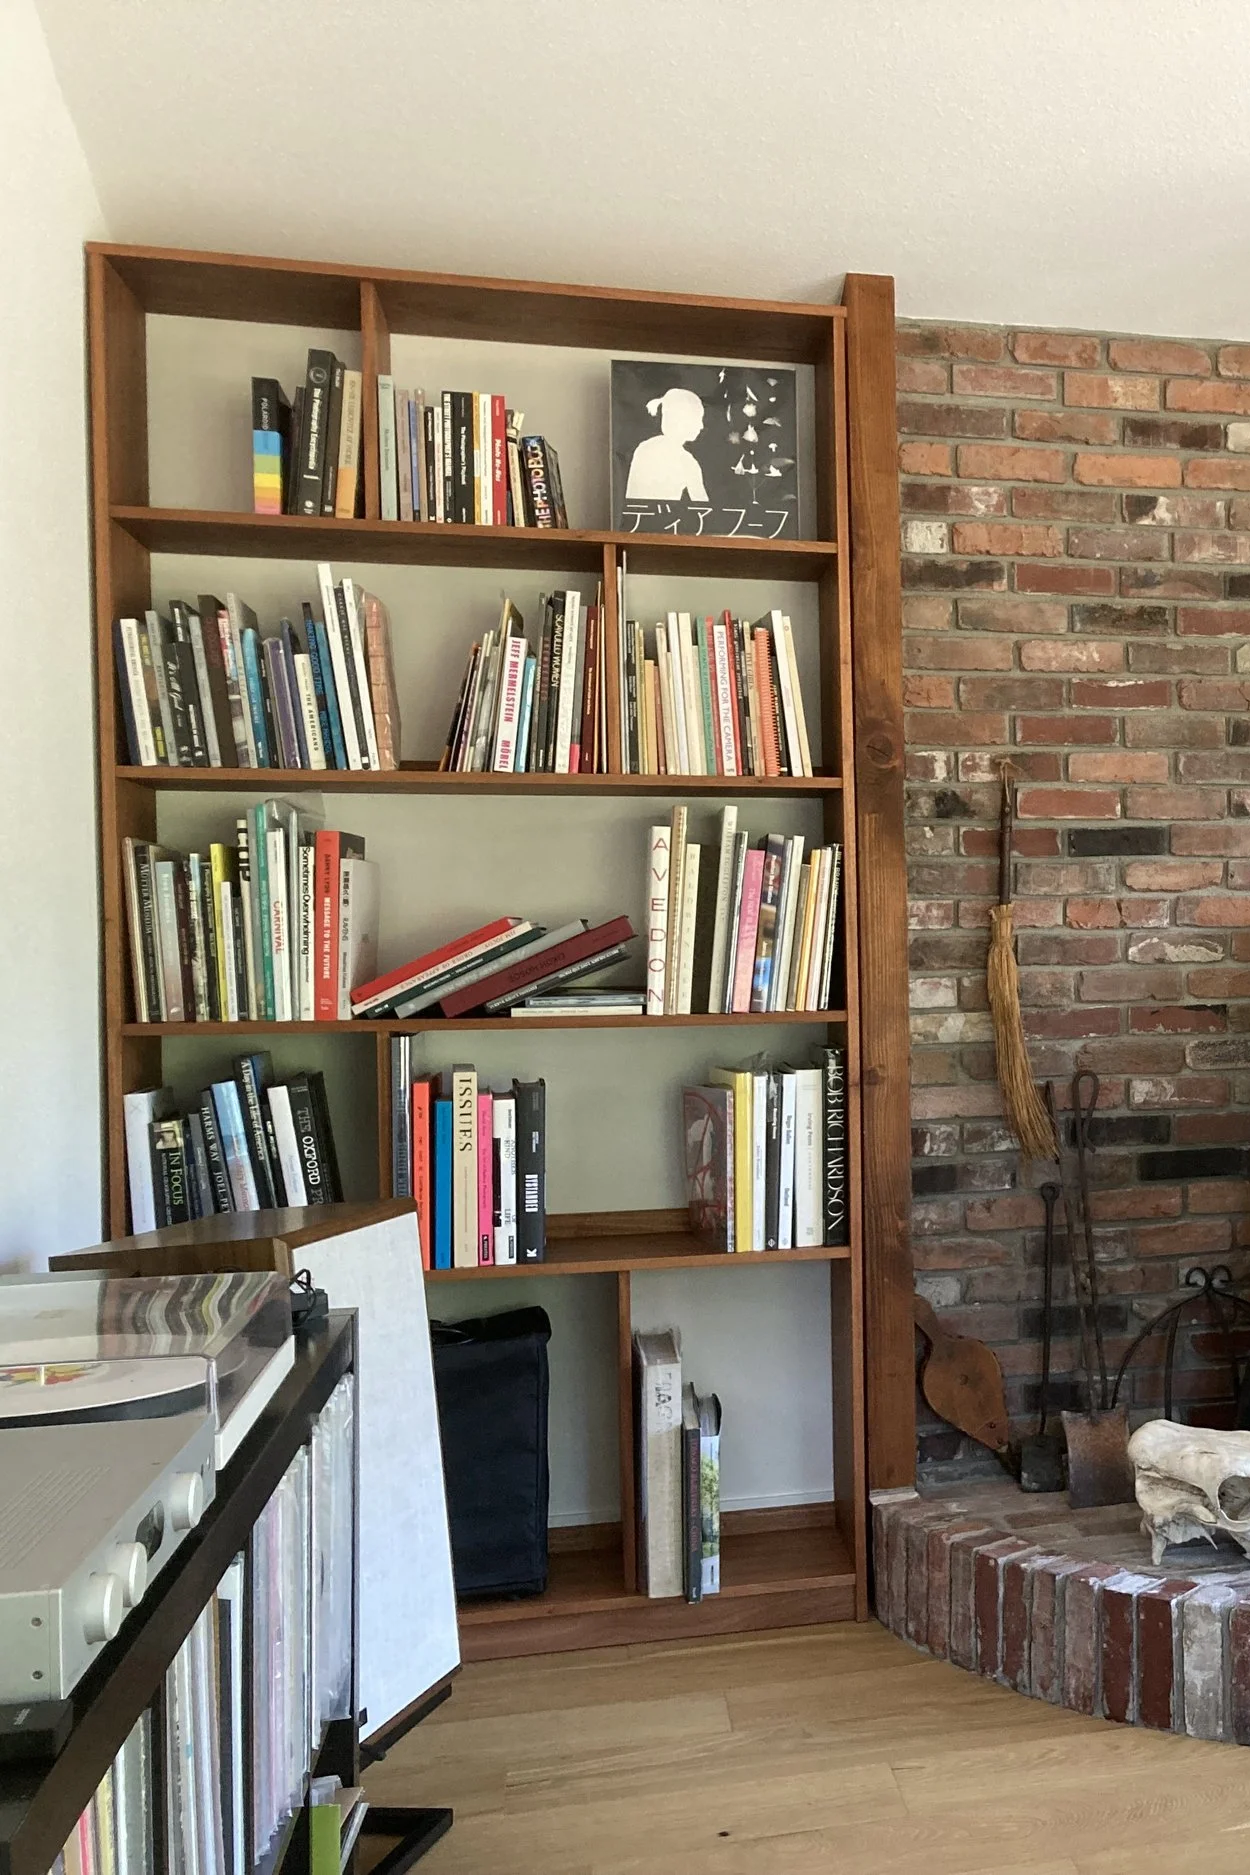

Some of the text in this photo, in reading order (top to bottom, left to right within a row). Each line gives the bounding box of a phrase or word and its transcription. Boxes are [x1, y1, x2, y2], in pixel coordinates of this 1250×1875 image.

[261, 397, 269, 430] POLAROID
[310, 399, 321, 433] Photography
[308, 433, 318, 470] Encyclopedia
[494, 438, 502, 482] Photo No-Nos
[310, 652, 321, 674] GOOD
[551, 613, 565, 687] SCAVULLO WOMEN
[313, 675, 324, 695] TIME
[504, 640, 521, 723] JEFF MERMELSTEIN
[717, 631, 734, 762] PERFORMING FOR THE CAMERA
[305, 694, 319, 752] THE AMERICANS
[301, 846, 312, 955] Sometimes Overwhelming
[322, 896, 332, 926] MESSAGE
[341, 917, 349, 941] RAVENS
[647, 836, 669, 1003] AVEDON
[323, 940, 331, 953] THE
[450, 949, 474, 965] ORDER
[323, 954, 331, 979] FUTURE
[242, 1069, 252, 1083] Day
[246, 1092, 256, 1104] the
[458, 1077, 473, 1152] ISSUES
[201, 1106, 214, 1140] HARMS
[209, 1142, 221, 1162] WAY
[297, 1107, 312, 1132] THE
[806, 1112, 814, 1130] Irving
[254, 1129, 265, 1161] America
[302, 1135, 321, 1185] OXFORD
[827, 1065, 846, 1230] BOB RICHARDSON
[169, 1152, 184, 1205] IN FOCUS
[525, 1174, 539, 1213] BYSTANDER
[504, 1208, 512, 1225] LIFE
[689, 1438, 699, 1553] EDWARD BURTYNSKY CHINA
